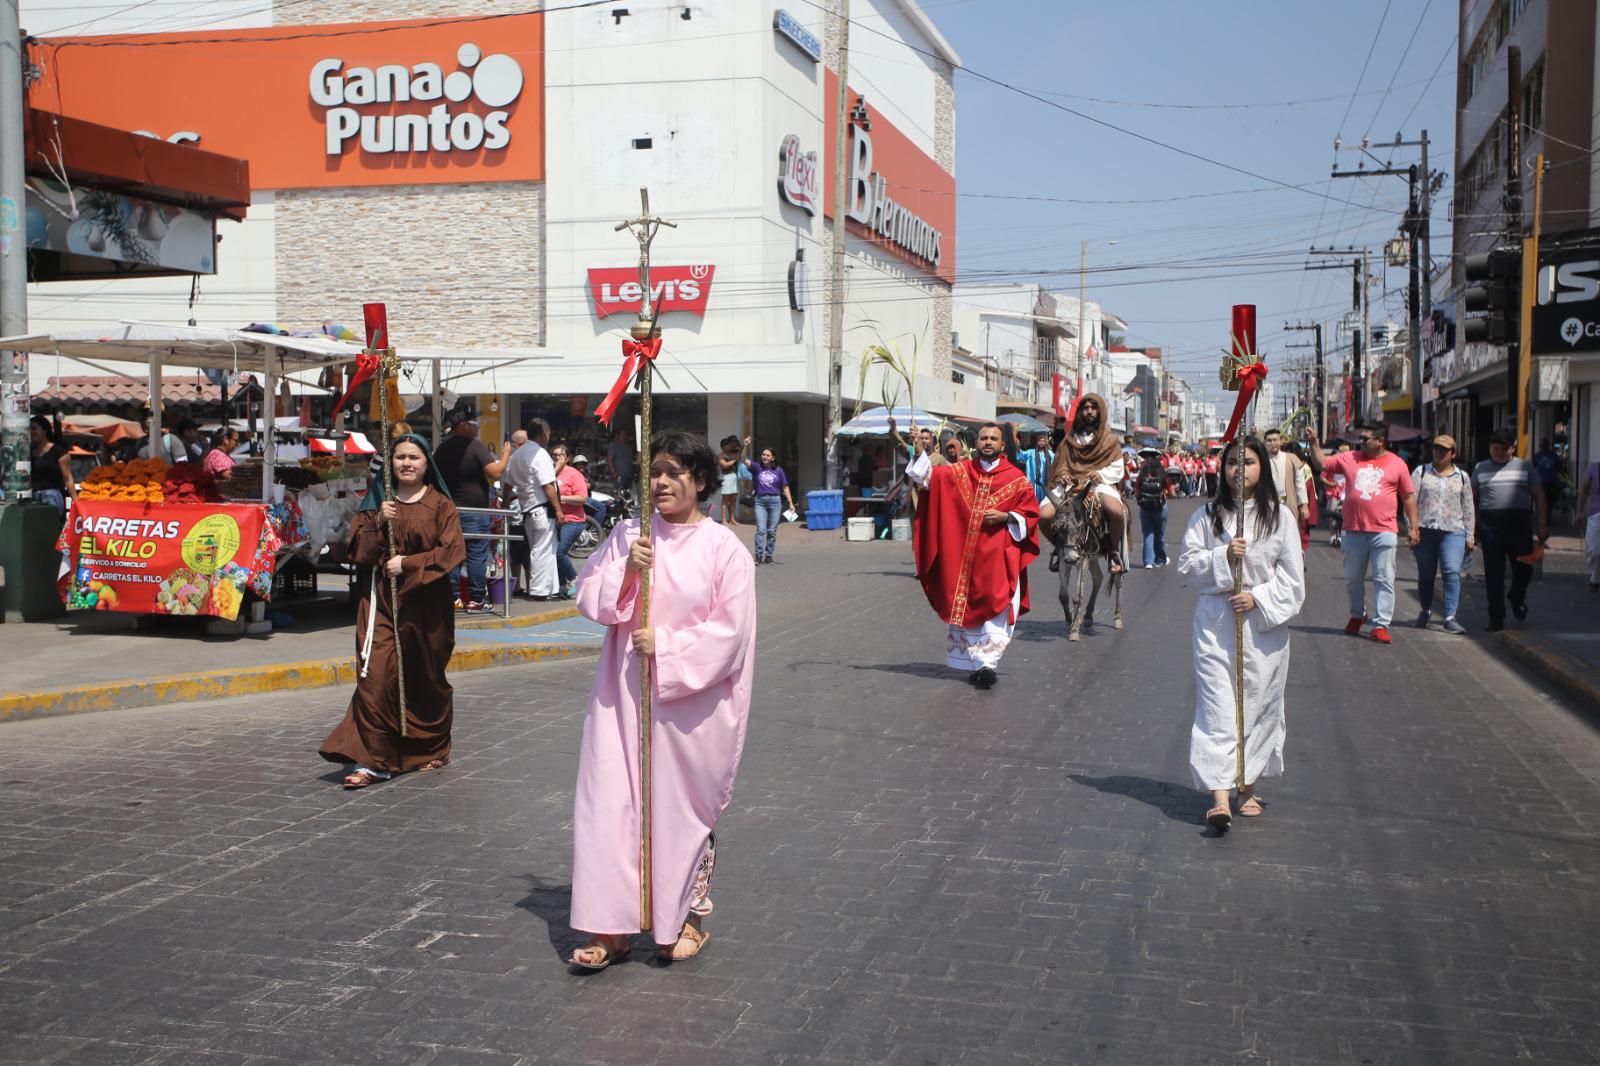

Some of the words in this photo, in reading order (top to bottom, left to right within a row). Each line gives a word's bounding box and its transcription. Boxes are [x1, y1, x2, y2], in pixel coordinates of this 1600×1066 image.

[309, 58, 443, 106] Gana
[326, 103, 511, 155] Puntos
[787, 139, 817, 193] flexi
[851, 123, 873, 224] B
[871, 171, 943, 267] Hermanos
[74, 516, 180, 539] CARRETAS
[79, 536, 103, 555] EL
[105, 539, 157, 559] KILO
[92, 571, 132, 582] CARRETAS
[132, 574, 143, 582] EL
[143, 575, 163, 583] KILO
